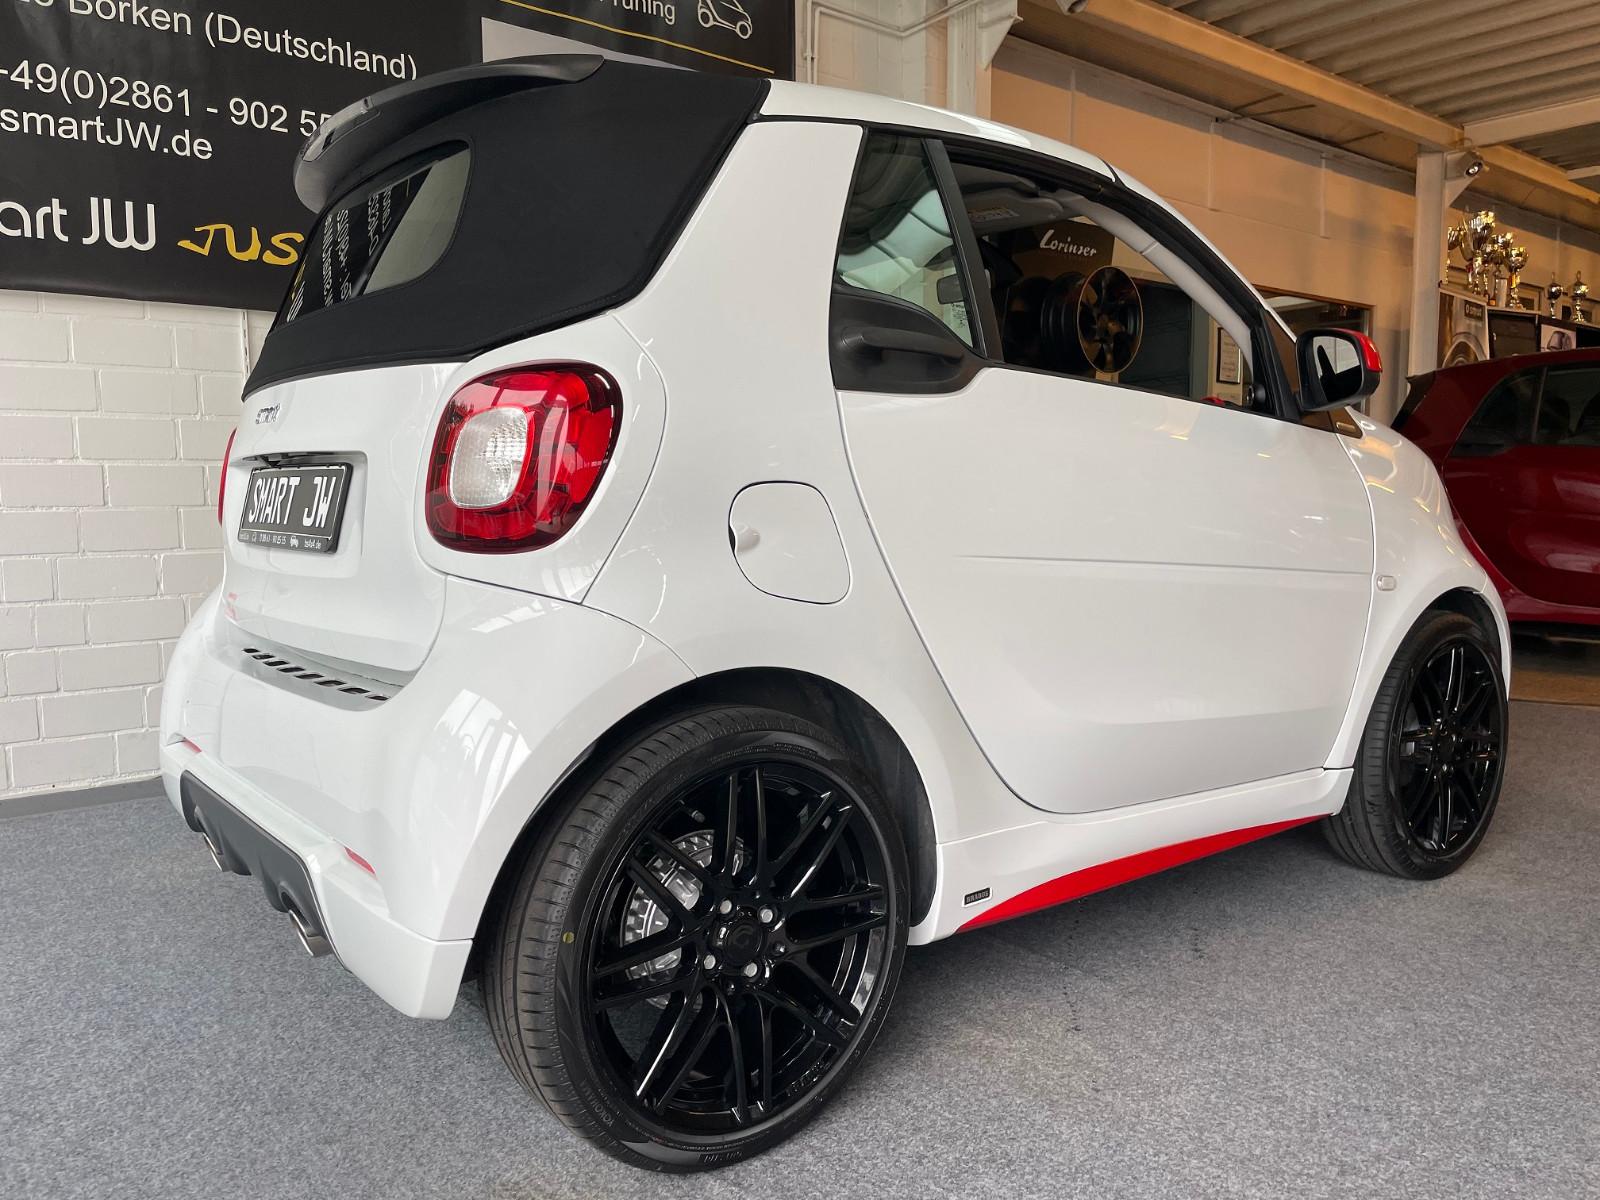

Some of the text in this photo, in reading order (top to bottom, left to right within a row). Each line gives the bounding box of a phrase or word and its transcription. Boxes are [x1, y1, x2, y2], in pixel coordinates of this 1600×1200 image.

[613, 0, 675, 25] uning
[206, 12, 417, 81] (Deutschland)
[0, 109, 213, 160] smartJW.de
[230, 98, 289, 133] 902
[300, 110, 332, 137] 5
[83, 197, 156, 251] JW
[1040, 229, 1097, 257] Lorinser
[249, 477, 336, 528] SMART JW
